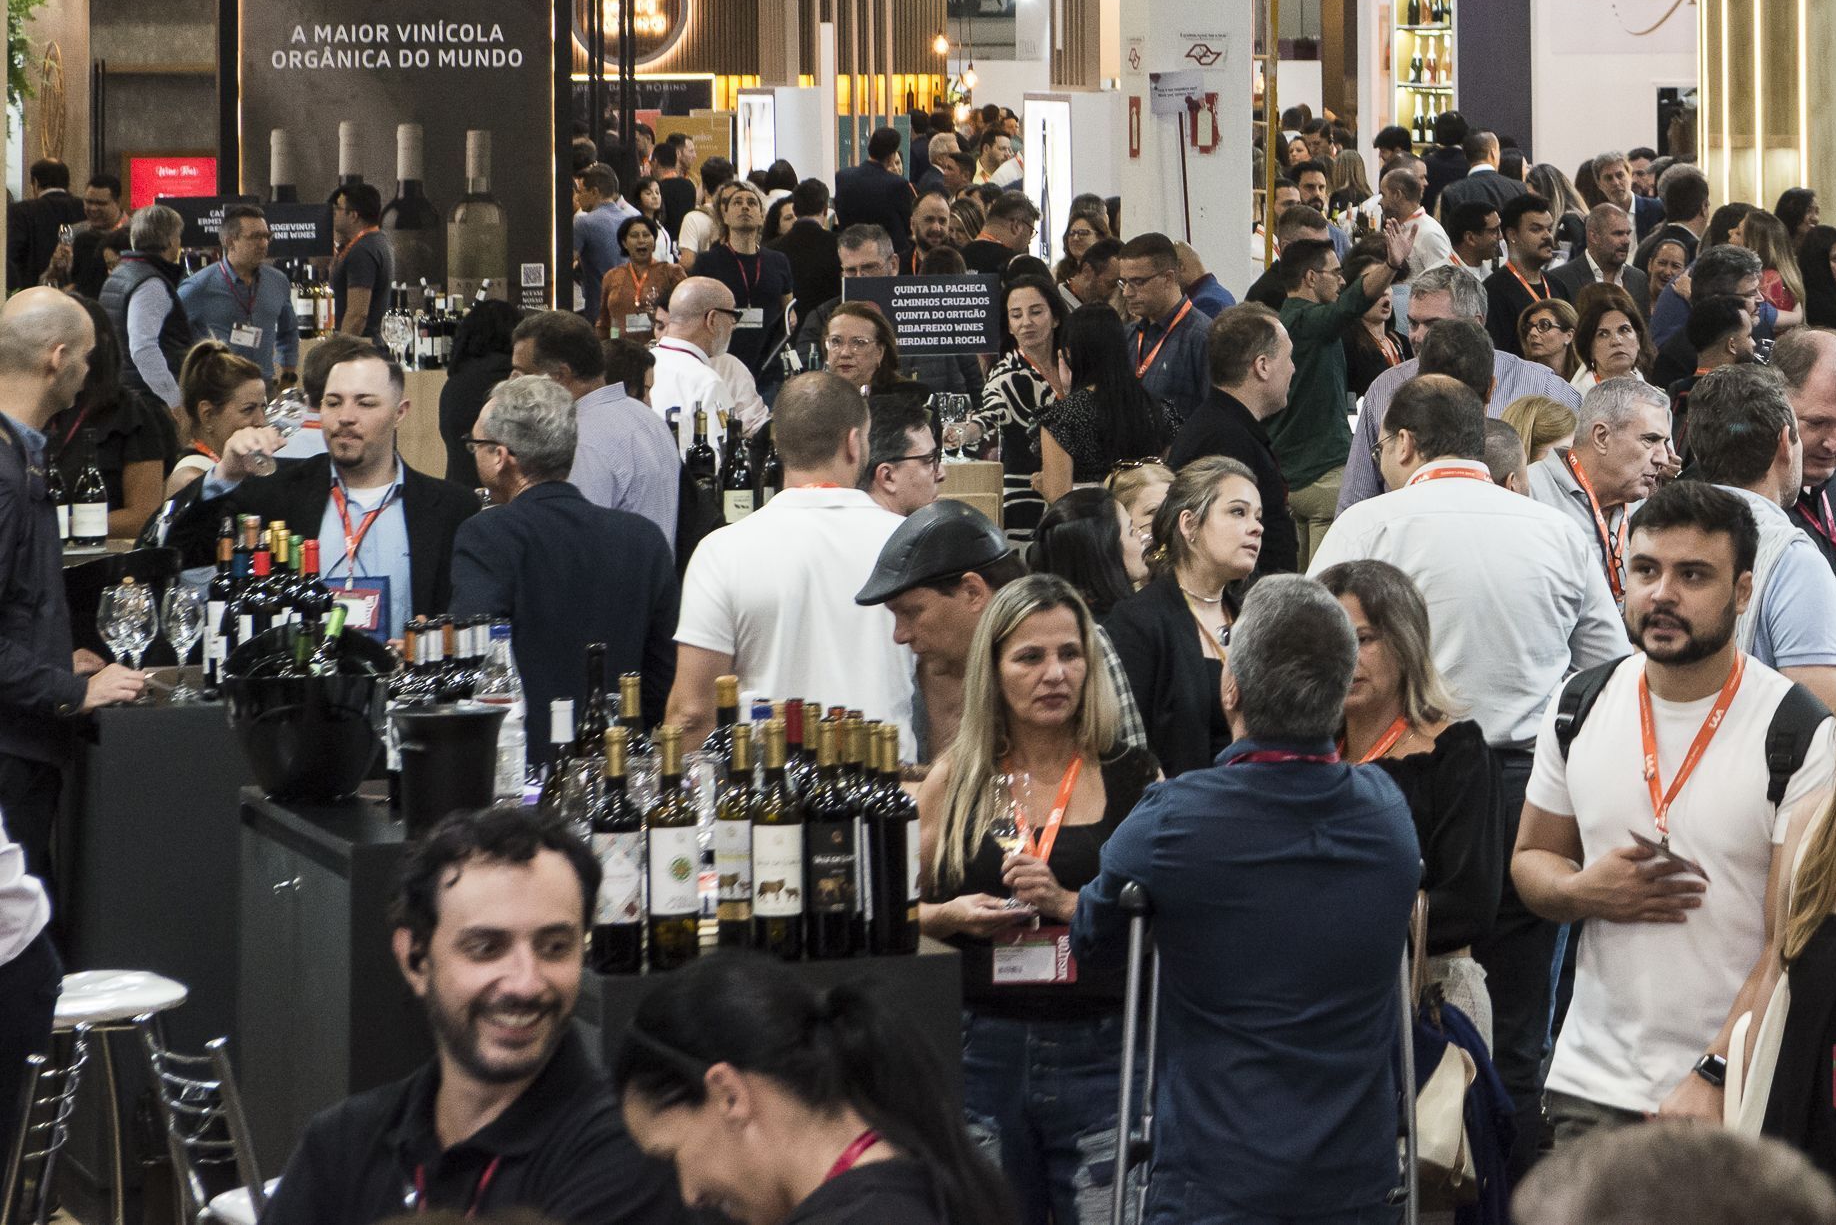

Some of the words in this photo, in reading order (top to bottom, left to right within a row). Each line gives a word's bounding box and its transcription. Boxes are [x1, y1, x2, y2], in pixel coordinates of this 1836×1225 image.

[290, 24, 307, 44] A
[314, 24, 390, 44] MAIOR
[396, 19, 505, 43] VINÍCOLA
[270, 45, 392, 70] ORGÂNICA
[398, 48, 430, 69] DO
[438, 48, 524, 68] MUNDO
[269, 223, 316, 232] SOGEVINUS
[274, 232, 289, 240] INE
[290, 231, 316, 240] WINES
[893, 285, 929, 295] QUINTA
[930, 285, 944, 293] DA
[945, 284, 987, 293] PACHECA
[891, 298, 940, 307] CAMINHOS
[941, 297, 990, 306] CRUZADOS
[895, 311, 930, 321] QUINTA
[932, 311, 945, 319] DO
[946, 308, 986, 319] ORTIGÃO
[897, 324, 953, 333] RIBAFREIXO
[954, 323, 984, 331] WINES
[895, 337, 939, 346] HERDADE
[940, 336, 953, 345] DA
[955, 335, 987, 344] ROCHA
